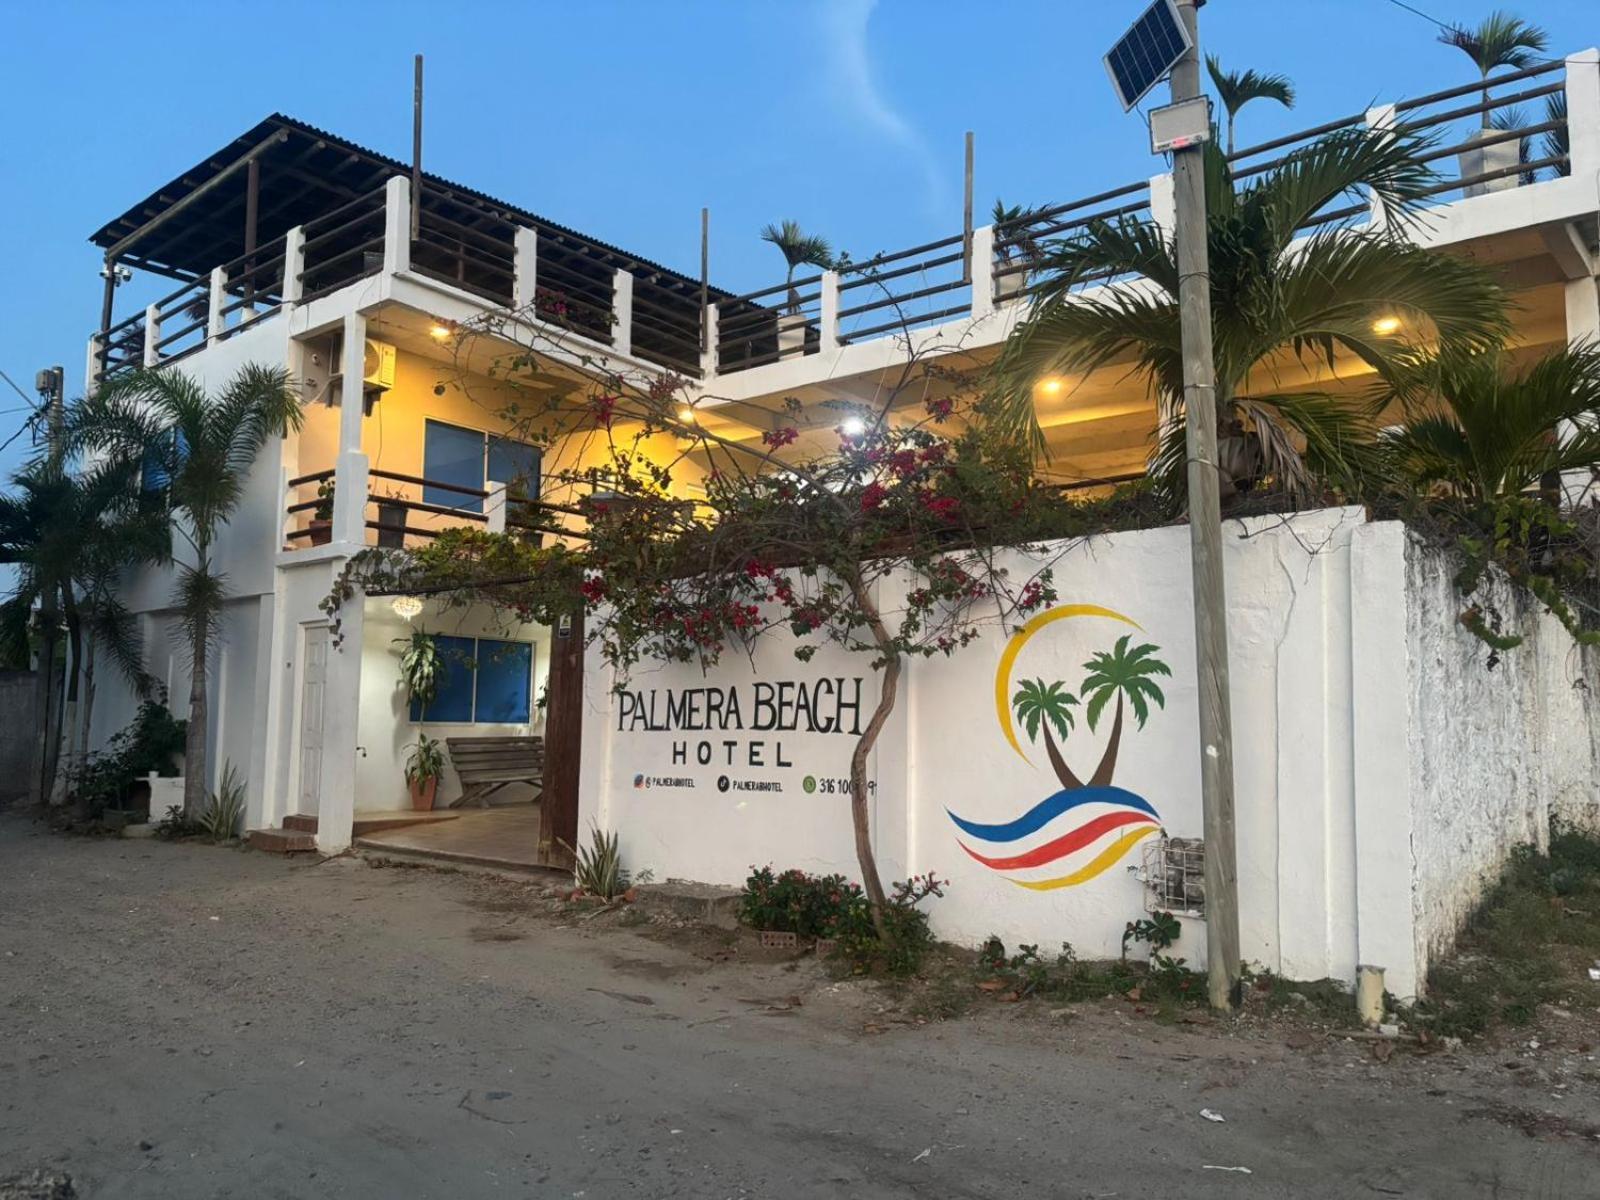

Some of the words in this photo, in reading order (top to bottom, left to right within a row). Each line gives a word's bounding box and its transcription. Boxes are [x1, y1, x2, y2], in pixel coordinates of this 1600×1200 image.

[617, 686, 744, 732] PALMERA
[749, 677, 864, 736] BEACH
[672, 740, 793, 768] HOTEL
[819, 777, 836, 794] 316
